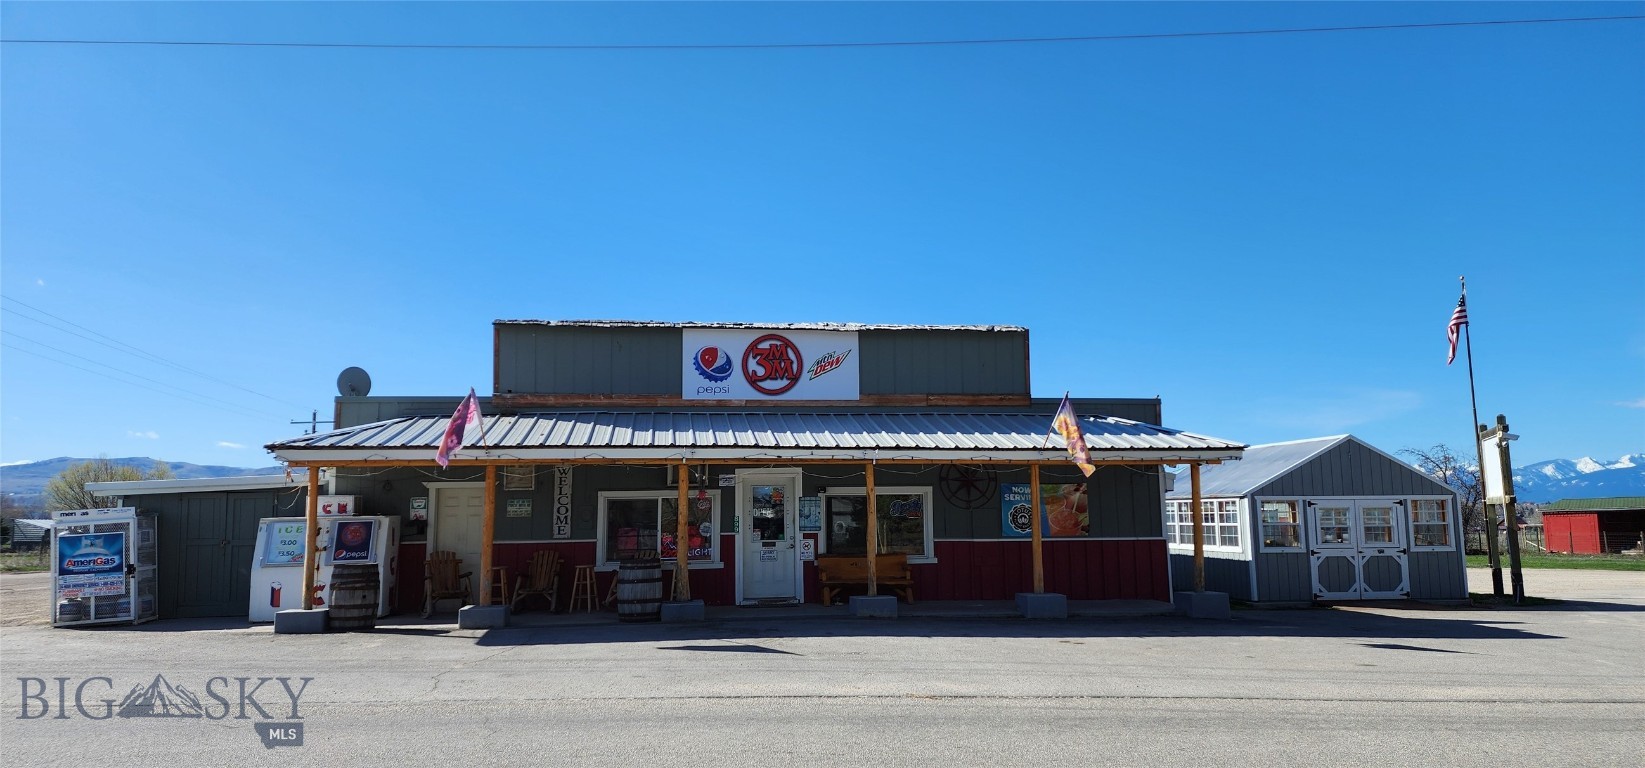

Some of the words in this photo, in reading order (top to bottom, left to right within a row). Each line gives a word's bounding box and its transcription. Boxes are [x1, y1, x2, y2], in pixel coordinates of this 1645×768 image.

[697, 385, 730, 395] pepsi
[555, 466, 571, 536] WELCOME
[278, 525, 303, 533] ICE
[346, 550, 367, 558] pepsi
[66, 557, 115, 566] AmeriGas
